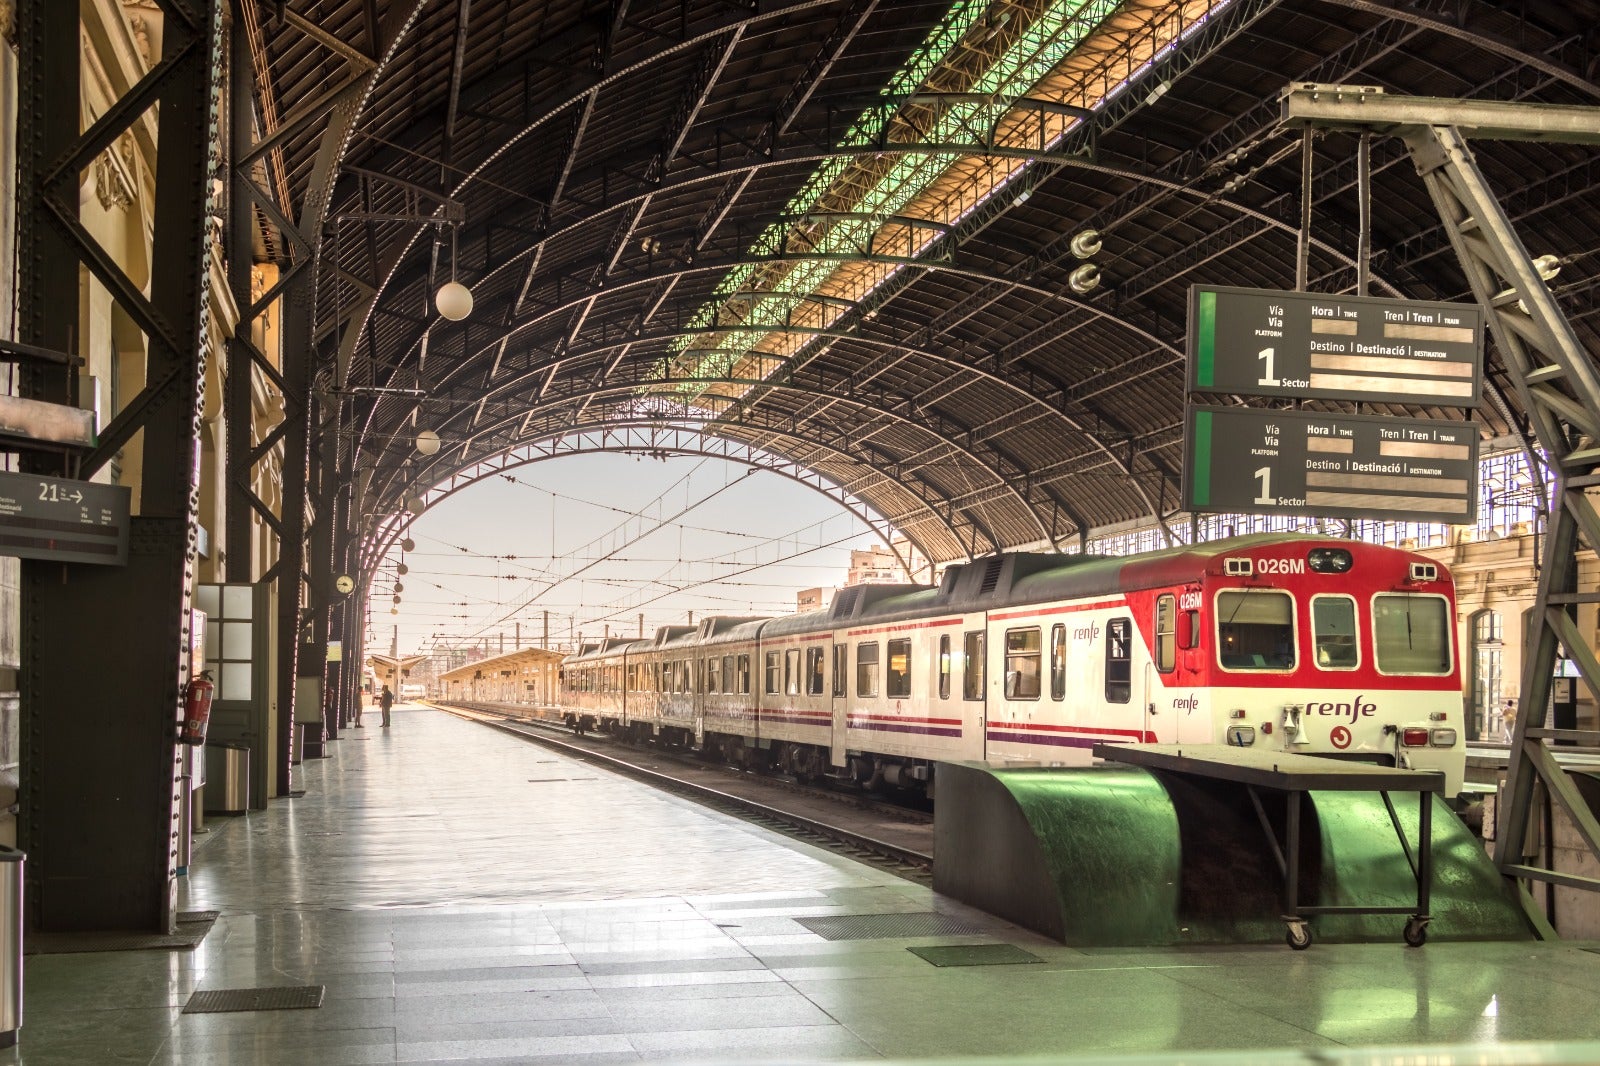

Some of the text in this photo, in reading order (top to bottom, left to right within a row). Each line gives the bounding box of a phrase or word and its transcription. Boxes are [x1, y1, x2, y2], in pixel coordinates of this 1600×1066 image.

[1269, 305, 1283, 316] Vía
[1311, 306, 1333, 317] Hora
[1384, 311, 1403, 321] Tren
[1413, 313, 1433, 323] Tren
[1255, 329, 1283, 337] PLATFORM
[1310, 341, 1345, 352] Destino
[1356, 343, 1405, 356] Destinació
[1258, 347, 1281, 387] 1
[1282, 377, 1310, 388] Sector
[1265, 424, 1280, 435] Vía
[1307, 424, 1329, 435] Hora
[1380, 428, 1399, 439] Tren
[1408, 430, 1429, 441] Tren
[1251, 448, 1279, 456] PLATFORM
[1306, 459, 1442, 476] Destino Destinació DESTINATION
[39, 482, 59, 502] 21
[1254, 466, 1277, 506] 1
[1278, 496, 1305, 507] Sector
[1257, 558, 1305, 574] 026M
[1180, 591, 1203, 609] 026M
[1073, 620, 1100, 646] renfe
[1172, 693, 1199, 716] renfe
[1305, 694, 1377, 725] renfe
